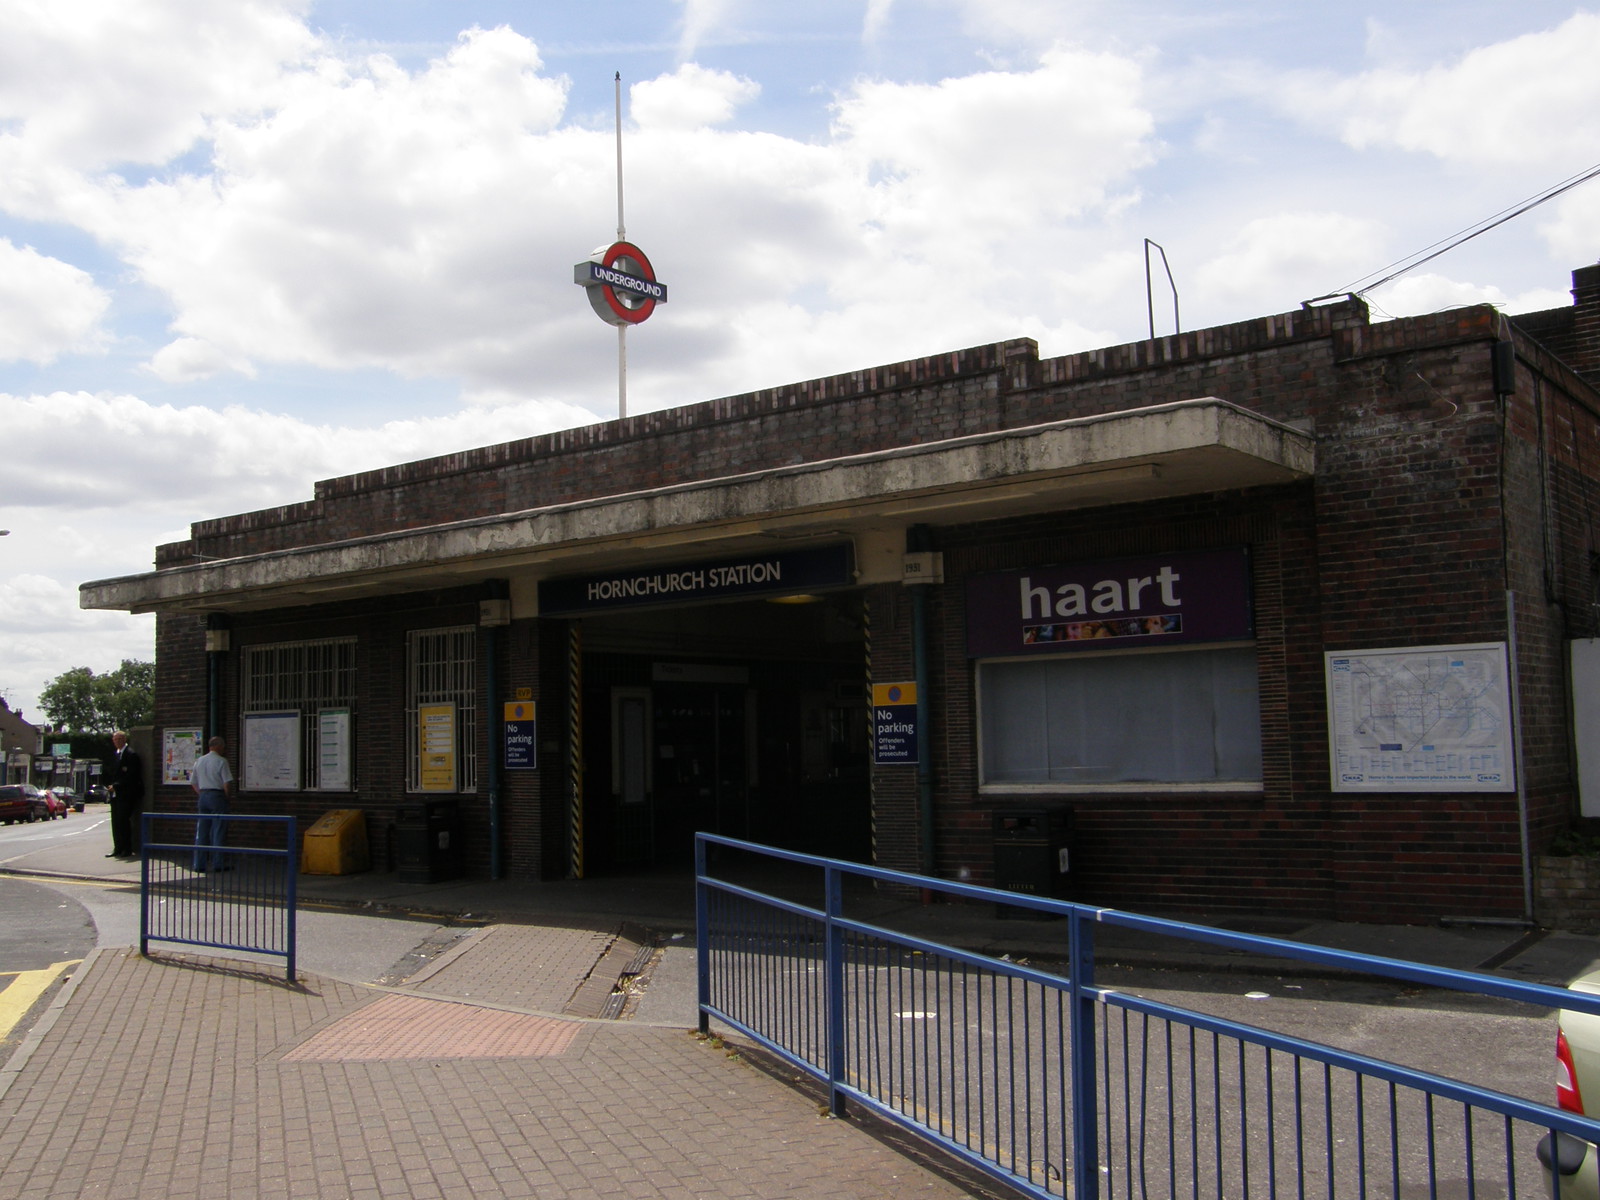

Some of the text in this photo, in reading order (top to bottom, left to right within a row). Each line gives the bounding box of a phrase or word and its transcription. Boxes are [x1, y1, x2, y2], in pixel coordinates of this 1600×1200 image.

[594, 267, 661, 297] UNDERGROUND
[588, 561, 781, 600] HORNCHURCH STATION
[1020, 566, 1182, 619] haart
[877, 710, 892, 720] No
[507, 724, 518, 733] No
[878, 722, 914, 735] parking
[507, 734, 532, 745] parking
